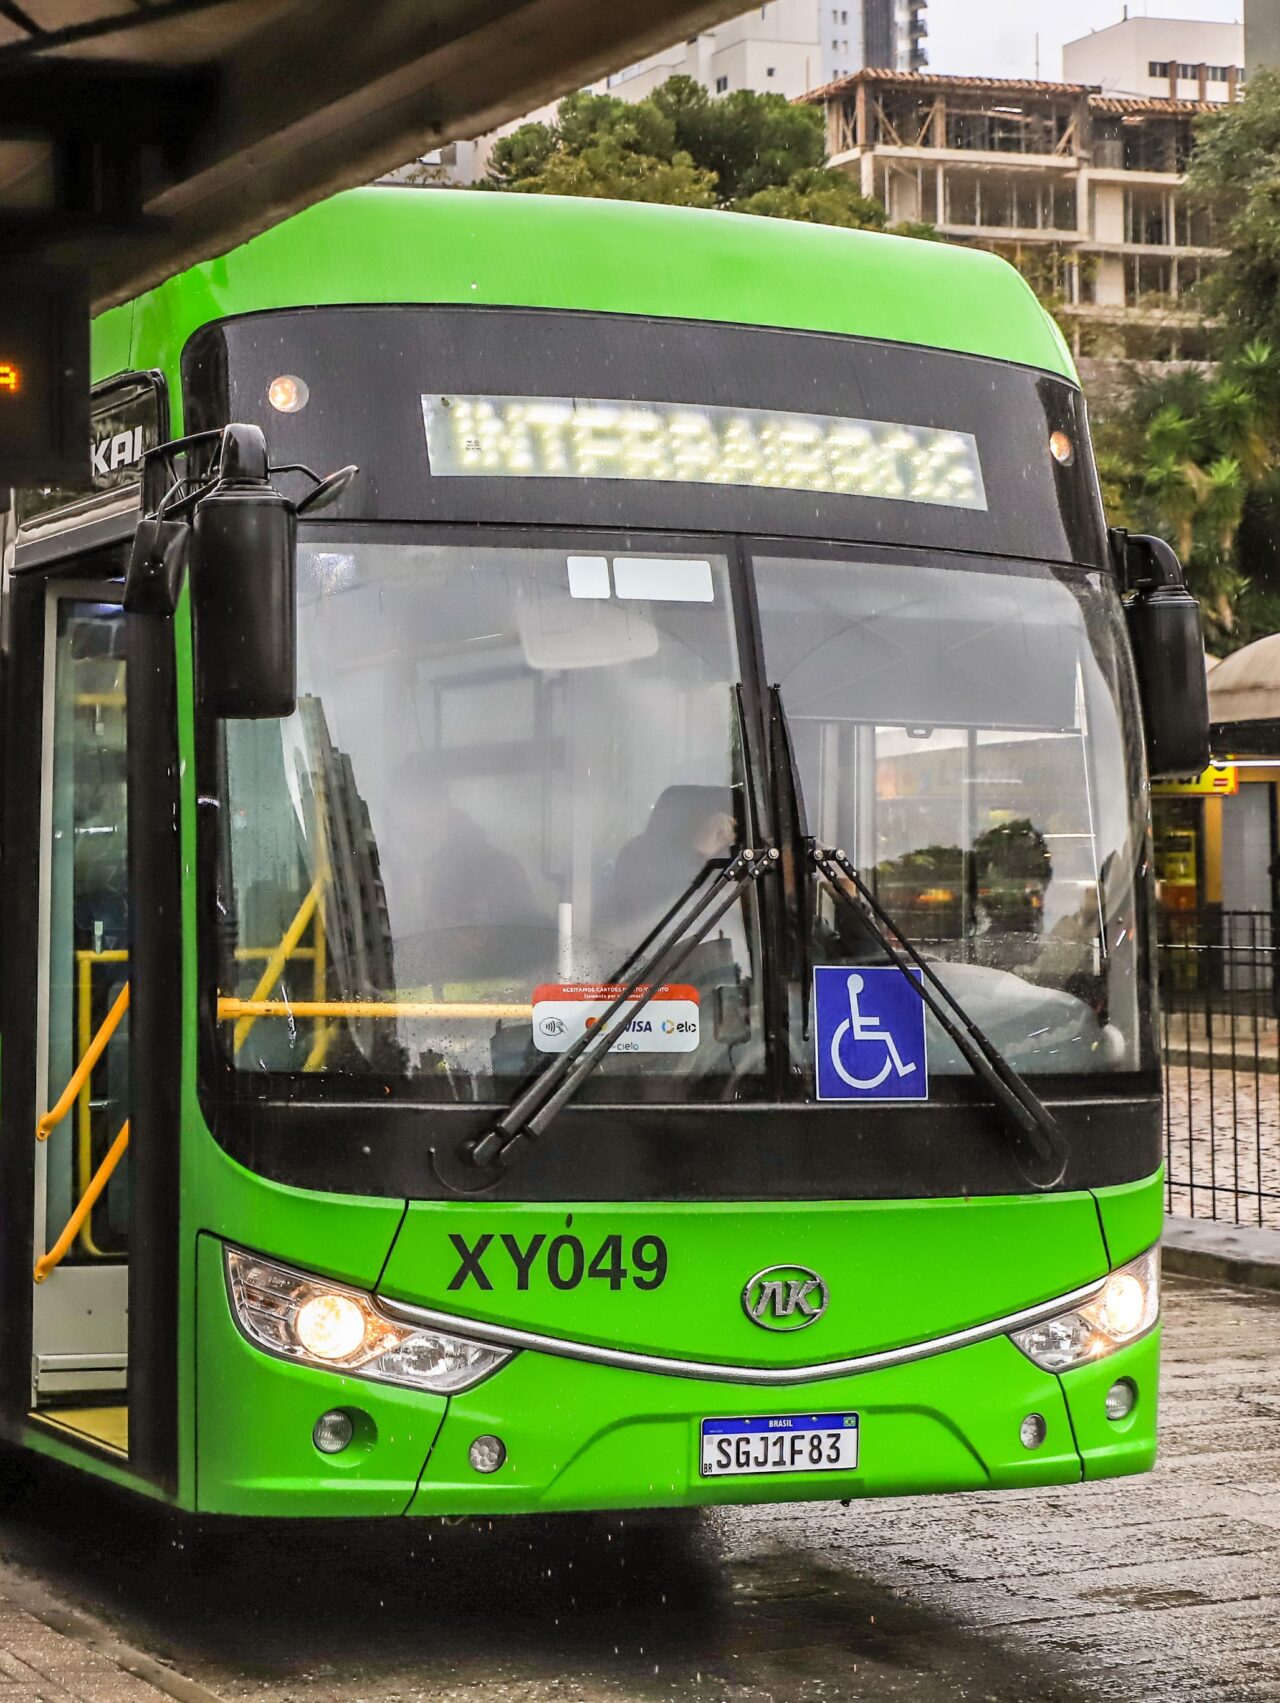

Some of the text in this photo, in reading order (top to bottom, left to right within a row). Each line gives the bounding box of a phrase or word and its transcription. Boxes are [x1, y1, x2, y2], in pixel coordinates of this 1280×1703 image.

[616, 1041, 639, 1051] cielo
[447, 1233, 668, 1291] XY049
[768, 1420, 793, 1428] BRASIL
[716, 1433, 841, 1469] SGJ1F83
[703, 1463, 713, 1473] BR
